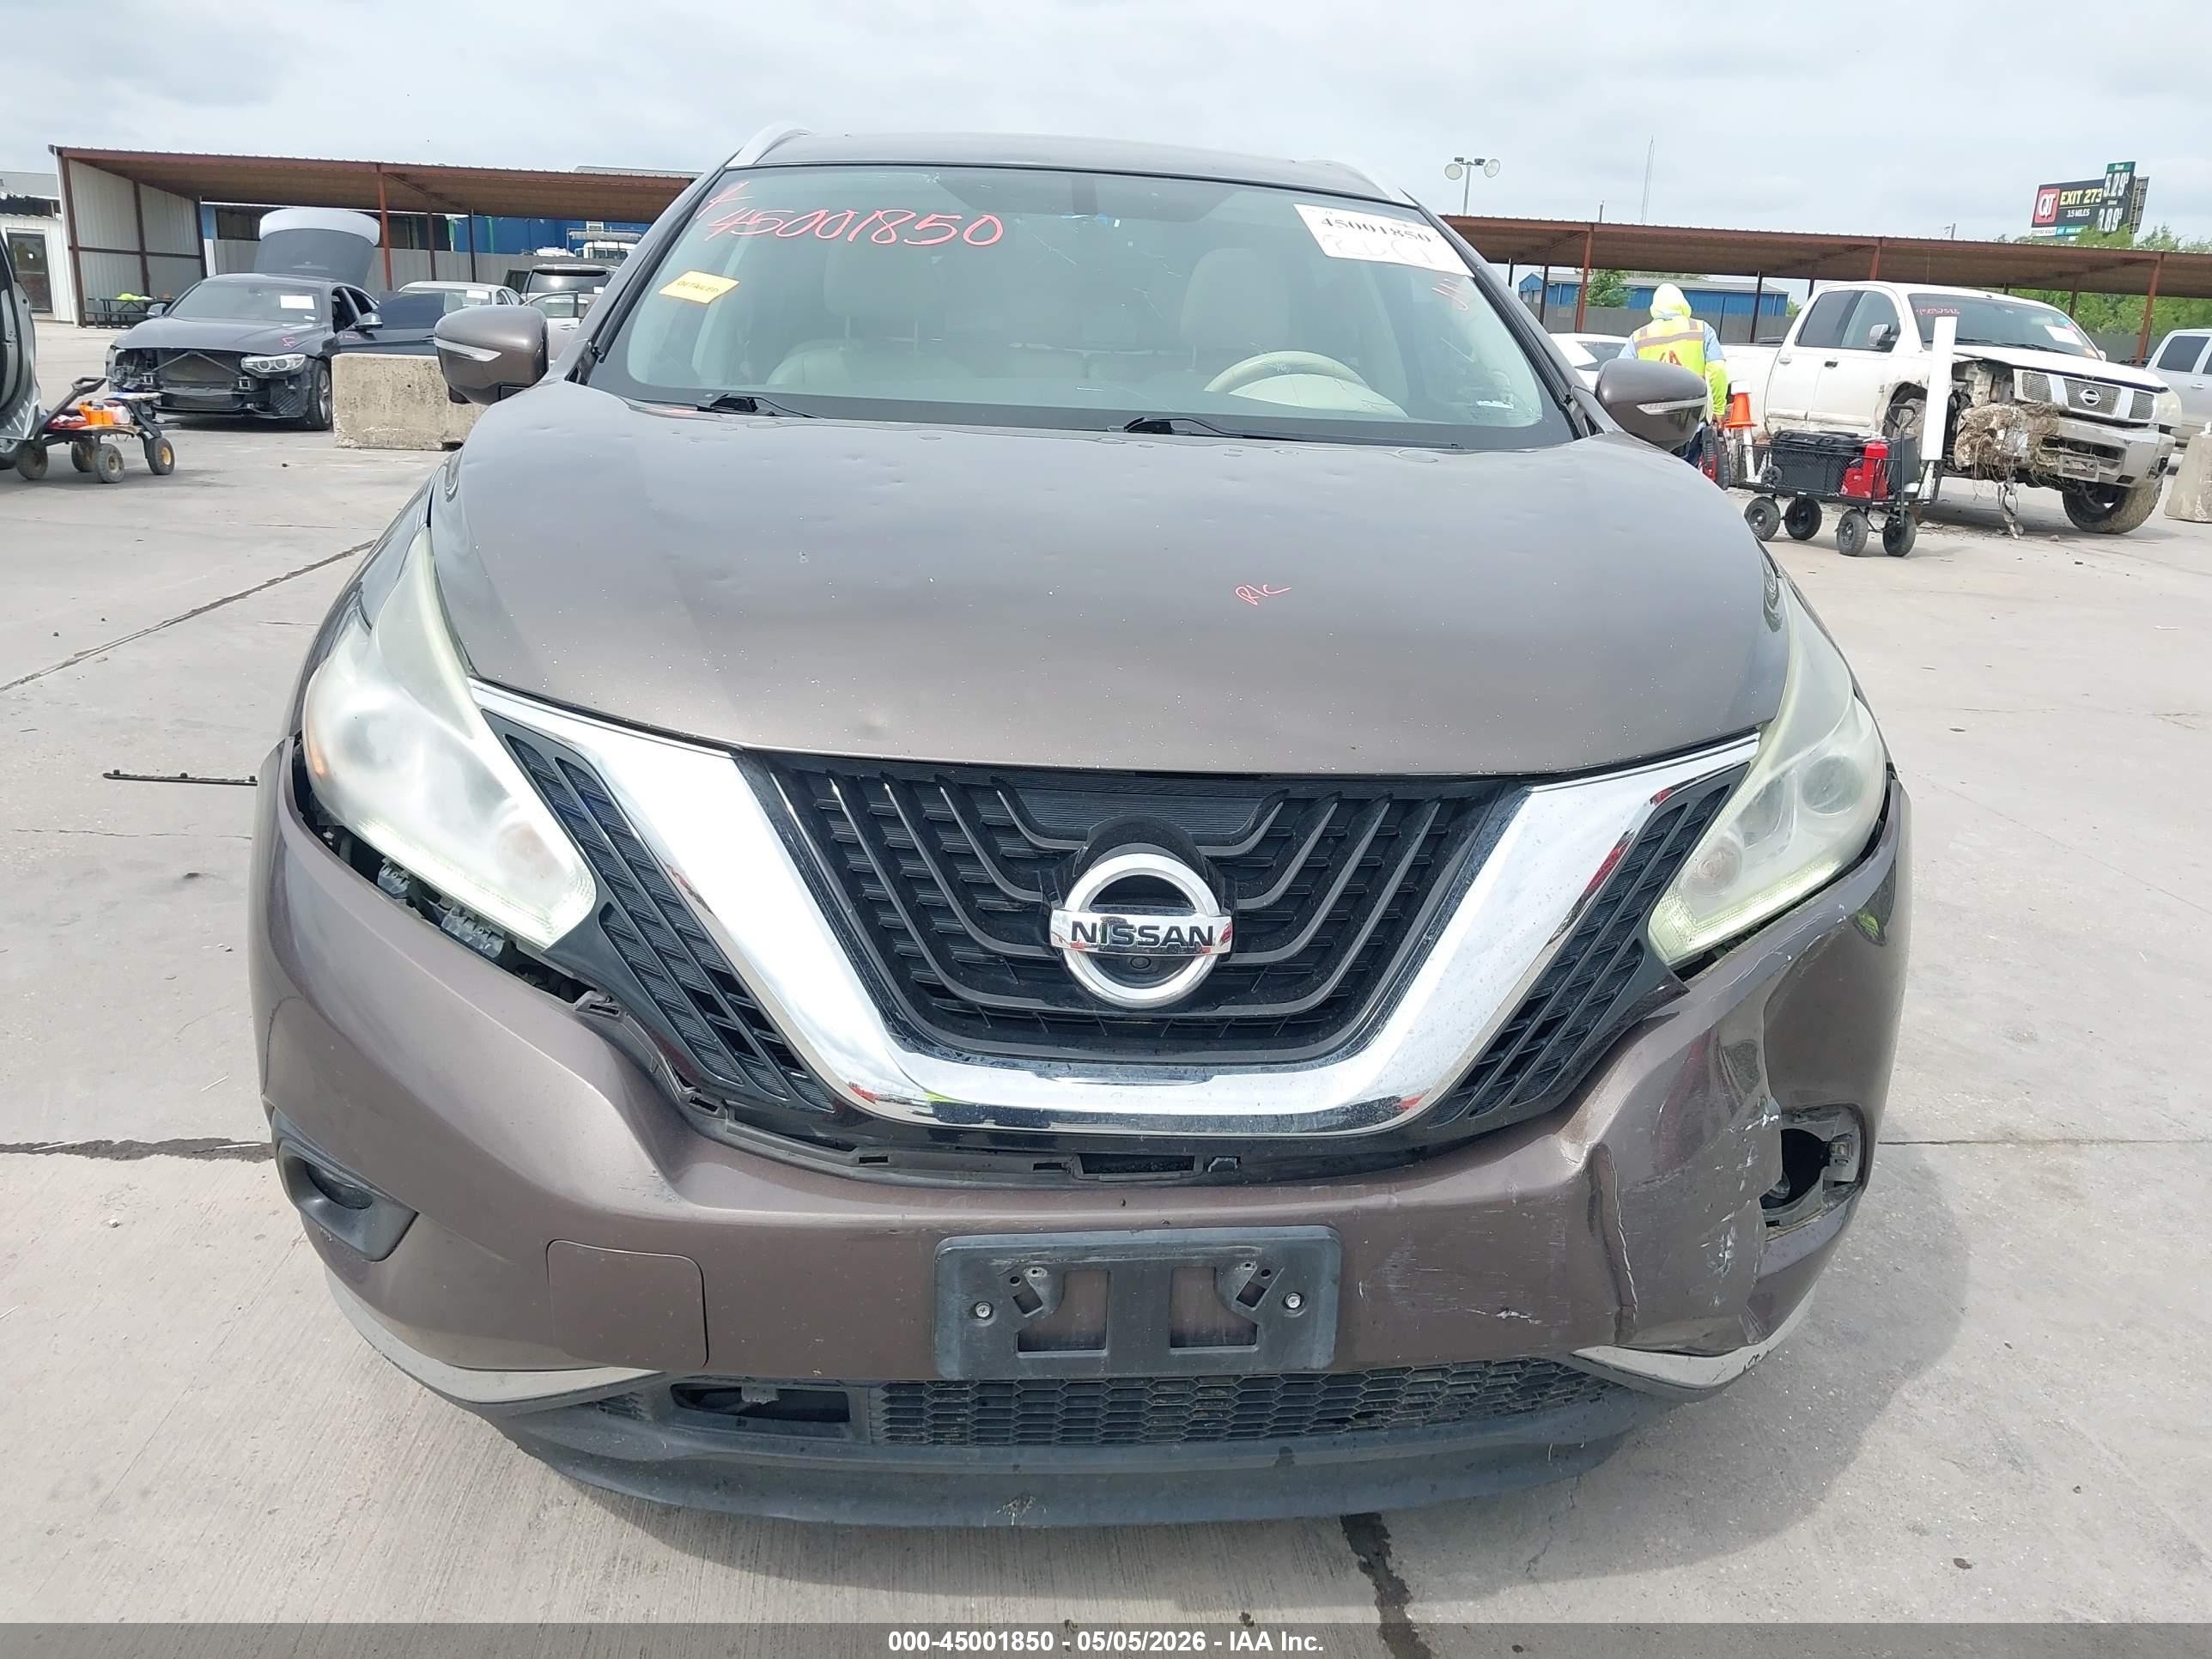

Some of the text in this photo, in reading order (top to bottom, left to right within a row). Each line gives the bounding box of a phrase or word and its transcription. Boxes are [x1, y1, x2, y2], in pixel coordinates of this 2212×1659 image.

[2039, 193, 2057, 218] QT
[2059, 188, 2103, 205] EXIT 273
[704, 209, 1004, 246] 45001850
[1322, 217, 1431, 243] 45001850
[1071, 921, 1213, 948] NISSAN
